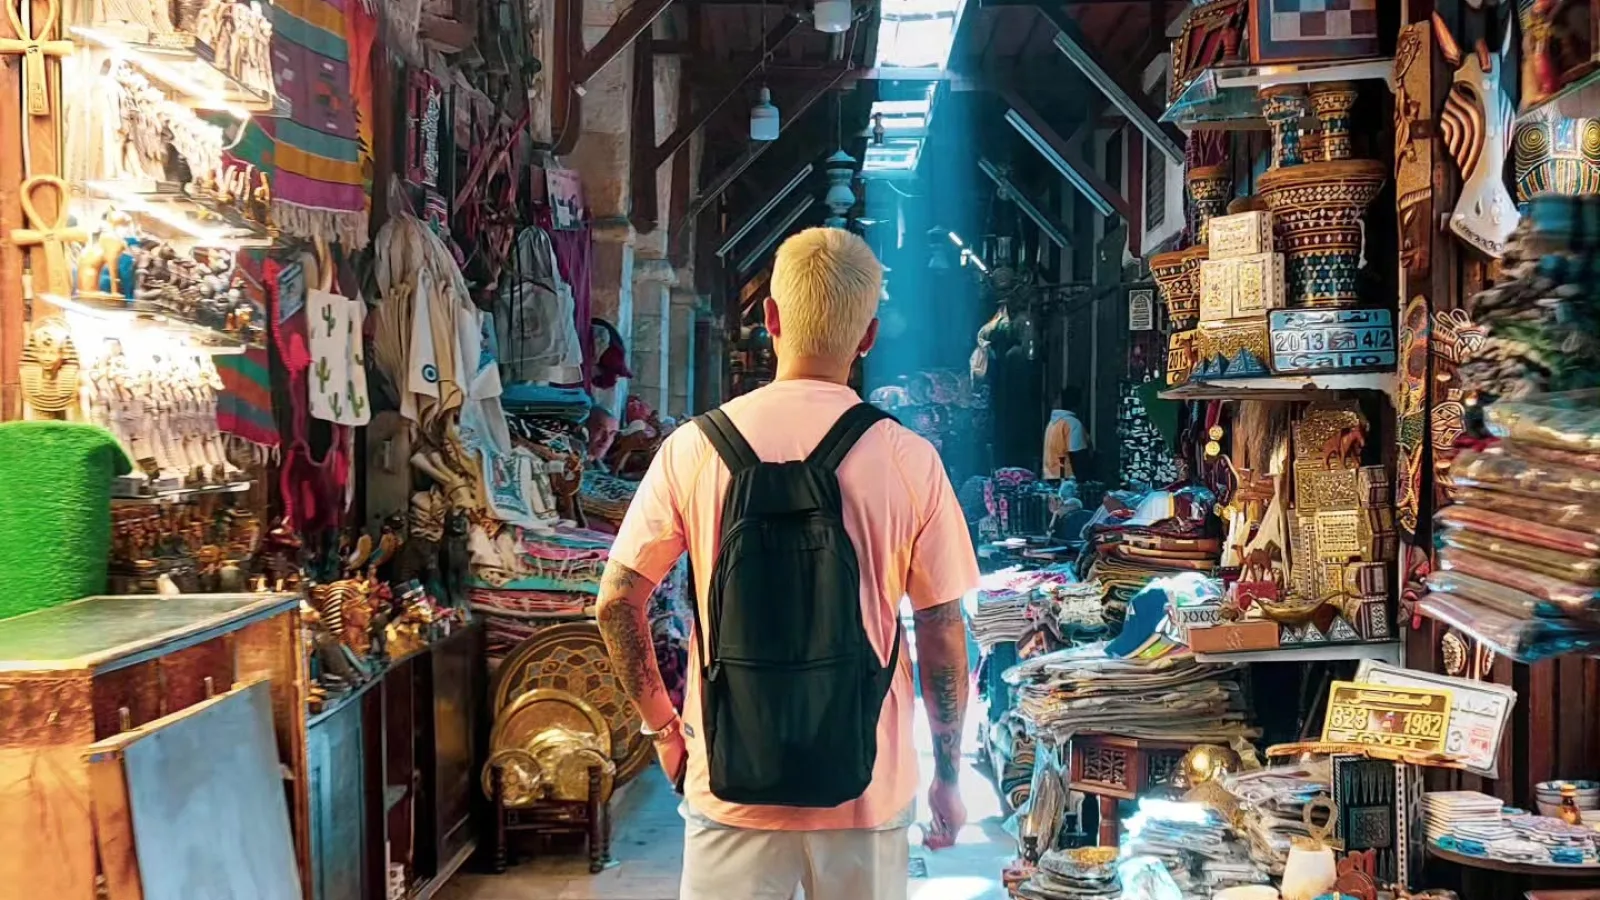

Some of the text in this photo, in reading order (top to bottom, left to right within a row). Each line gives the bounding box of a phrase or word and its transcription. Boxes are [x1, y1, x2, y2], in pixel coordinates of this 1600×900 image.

[1275, 329, 1392, 352] 2013 4/2
[1288, 352, 1381, 367] Cairo
[1346, 690, 1432, 706] مصر
[1331, 706, 1443, 736] 823 1982
[1346, 731, 1423, 748] EGYPT
